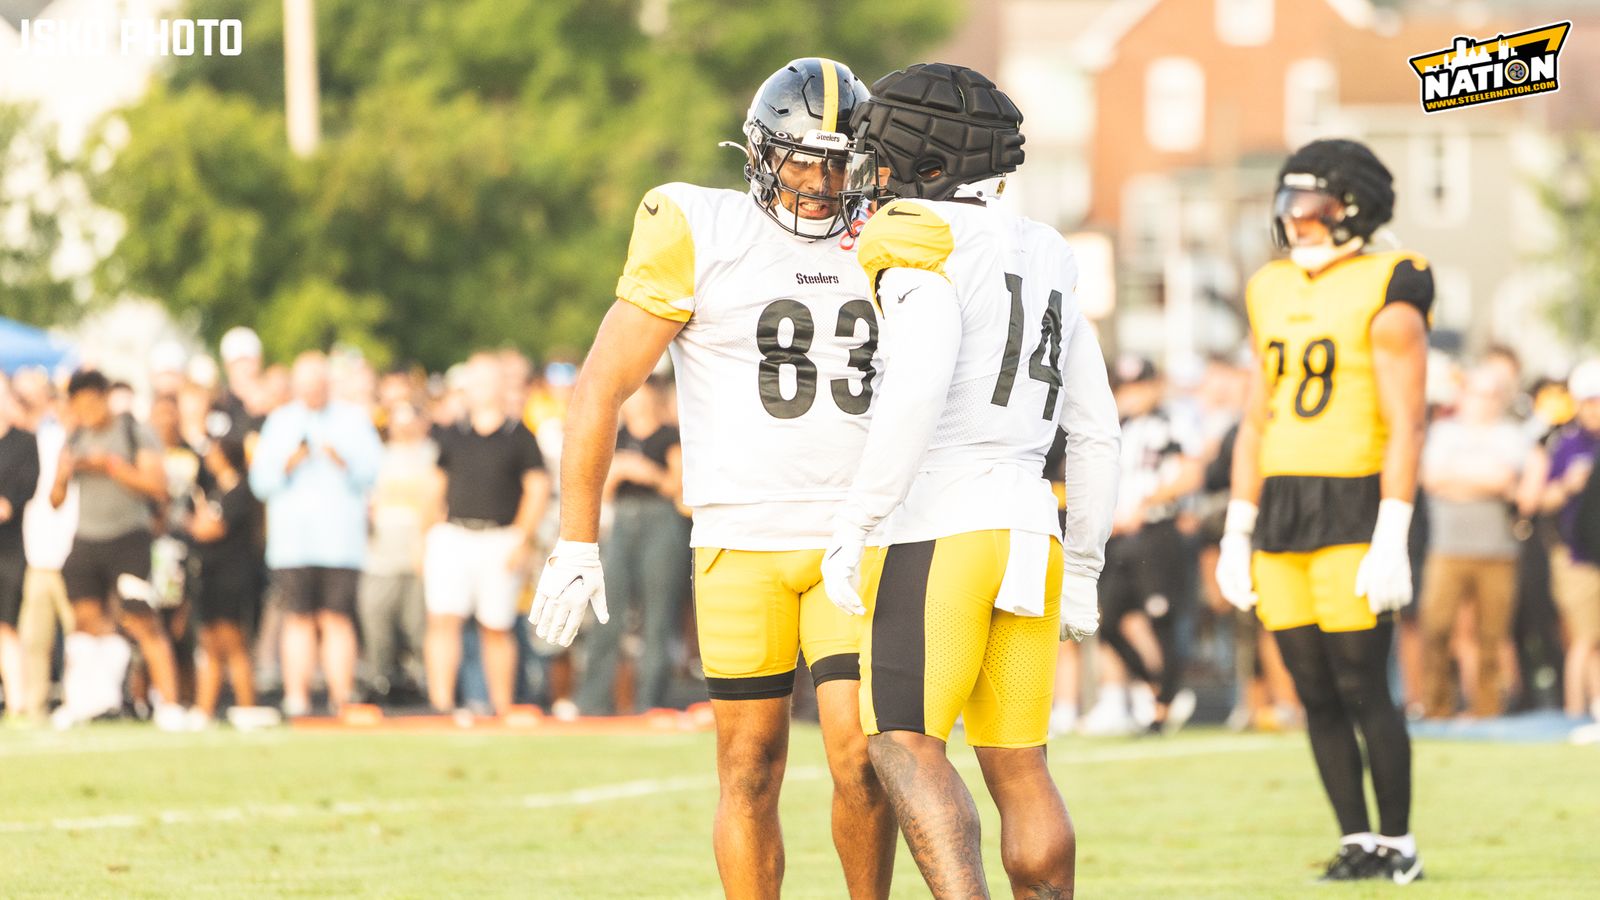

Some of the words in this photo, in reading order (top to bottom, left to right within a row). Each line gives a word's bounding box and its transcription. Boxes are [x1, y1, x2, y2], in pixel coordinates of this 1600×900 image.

[815, 132, 841, 143] Steelers
[795, 272, 840, 285] Steelers
[756, 299, 879, 420] 83
[990, 272, 1063, 421] 14
